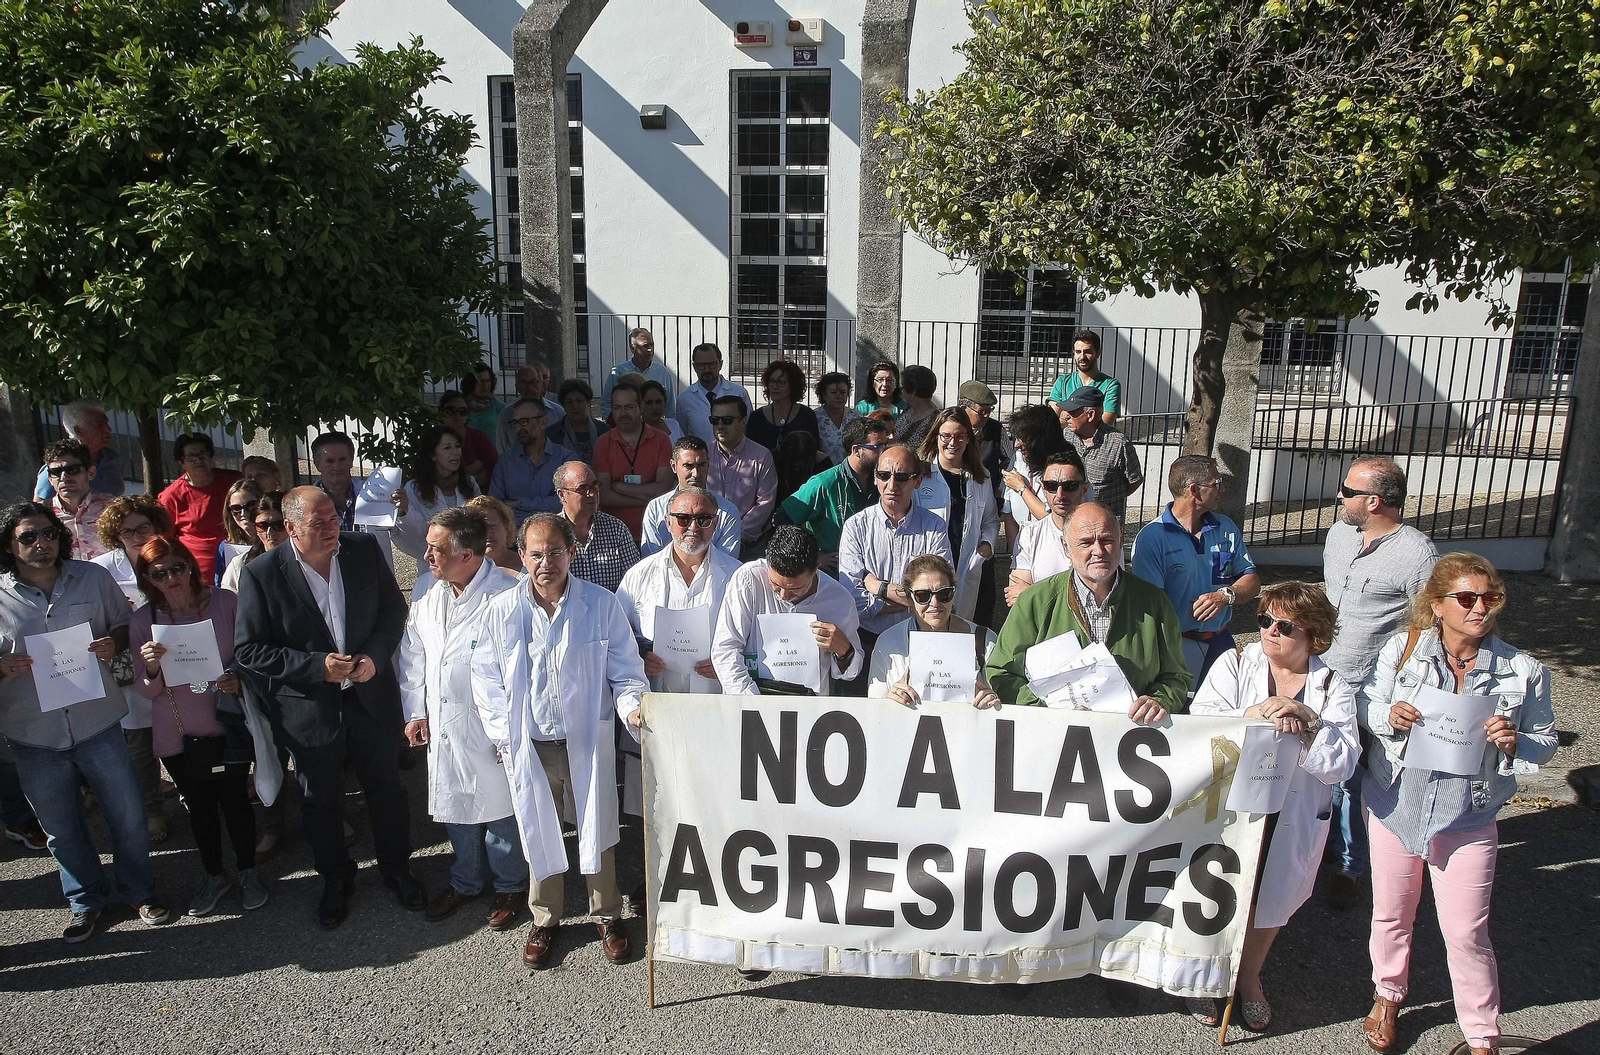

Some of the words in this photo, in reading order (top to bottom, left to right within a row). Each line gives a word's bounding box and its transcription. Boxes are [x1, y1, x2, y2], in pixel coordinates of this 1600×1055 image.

[666, 645, 699, 653] AGRESIONES
[49, 666, 86, 680] AGRESIONES
[1092, 684, 1099, 694] NO
[1082, 693, 1090, 704] LAS
[1428, 732, 1473, 746] AGRESIONES
[740, 710, 866, 808] NO
[897, 715, 961, 811] A
[994, 719, 1173, 824] LAS
[1249, 774, 1286, 782] AGRESIONES
[659, 822, 1242, 936] AGRESIONES
